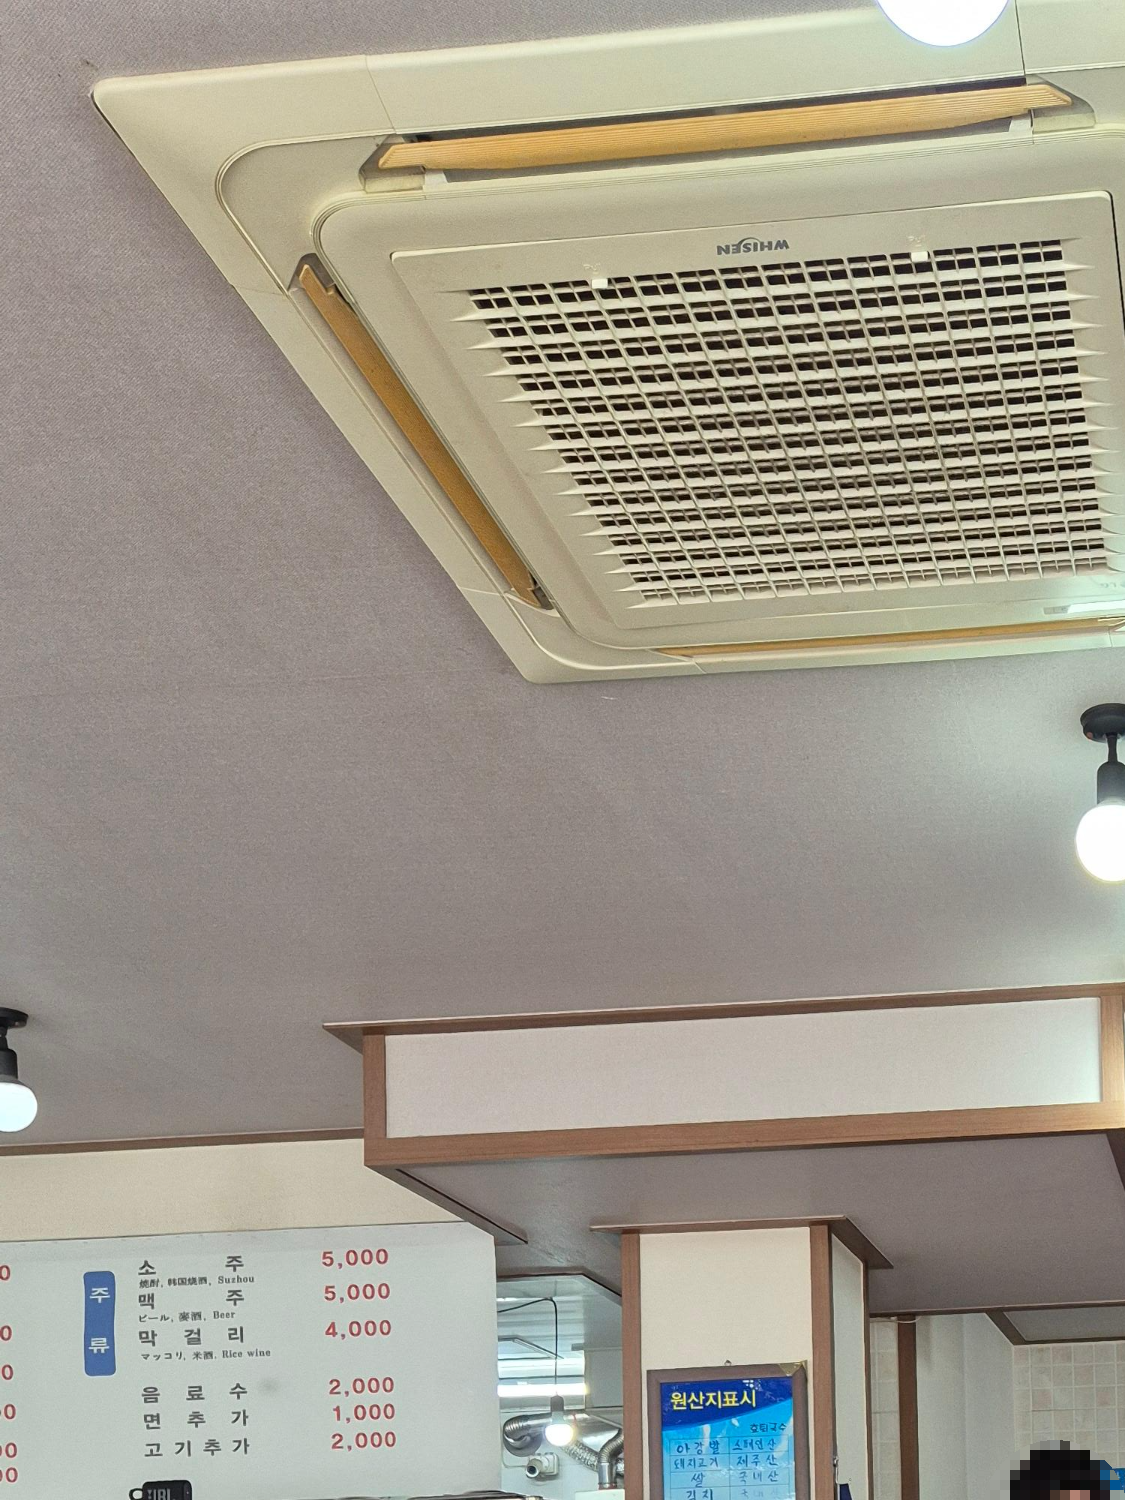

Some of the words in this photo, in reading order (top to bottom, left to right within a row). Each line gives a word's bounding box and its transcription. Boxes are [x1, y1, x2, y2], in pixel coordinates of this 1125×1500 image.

[716, 238, 790, 255] WHISEN
[322, 1249, 389, 1269] 5,000
[217, 1275, 255, 1284] Suzhou
[324, 1283, 391, 1304] 5,000
[213, 1310, 236, 1319] Beer
[325, 1320, 391, 1340] 4,000
[222, 1349, 243, 1358] Rice
[247, 1348, 271, 1357] wine
[329, 1377, 394, 1397] 2,000
[670, 1389, 756, 1410] 원산지표시
[332, 1404, 395, 1424] 1,000
[331, 1431, 397, 1452] 2,000
[691, 1472, 706, 1488] 쌀
